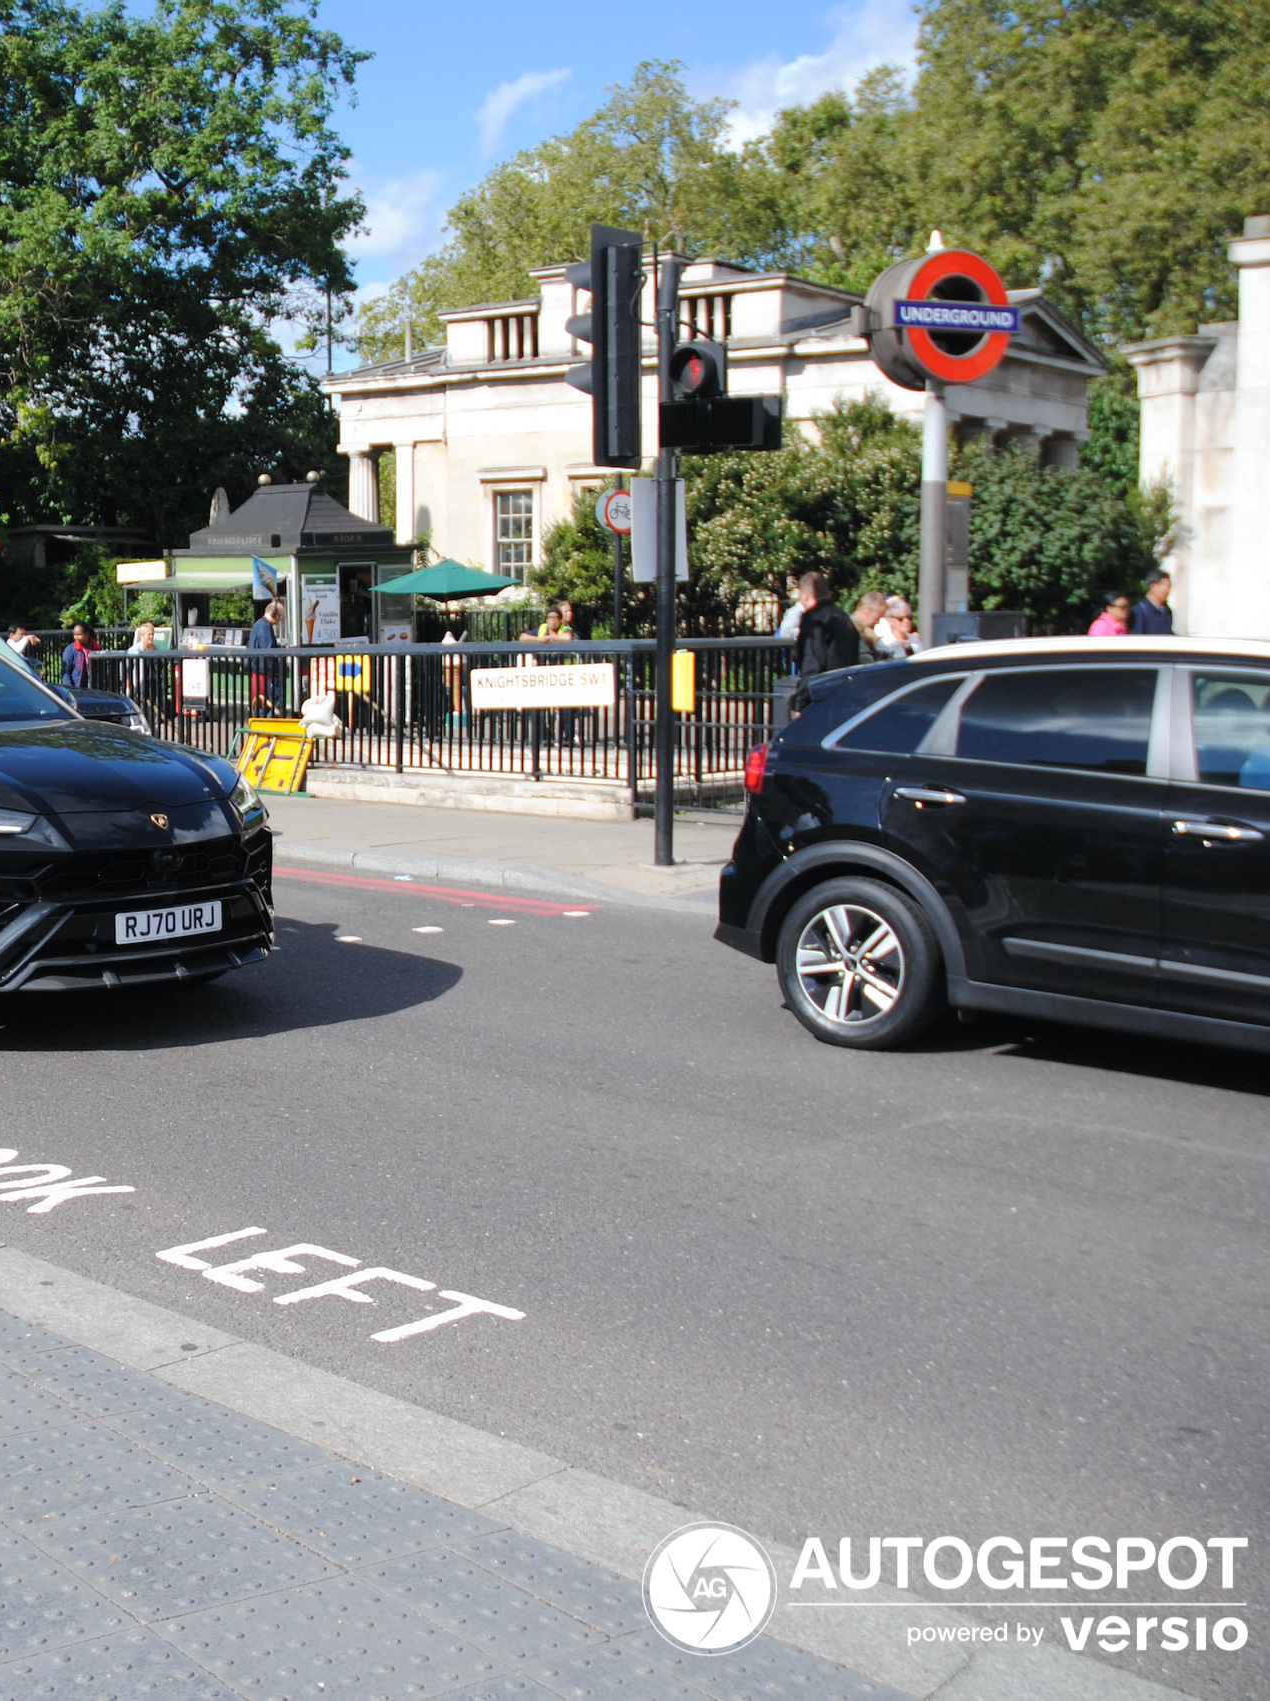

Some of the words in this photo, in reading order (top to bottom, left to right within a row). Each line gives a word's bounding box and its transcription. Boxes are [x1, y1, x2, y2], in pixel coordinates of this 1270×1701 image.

[900, 305, 1015, 328] UNDERGROUND
[477, 673, 575, 689] KNIGHTSBRIDGE
[580, 672, 607, 686] SW1
[125, 911, 176, 938] RJ70
[182, 905, 215, 931] URJ
[155, 1226, 527, 1343] LEFT
